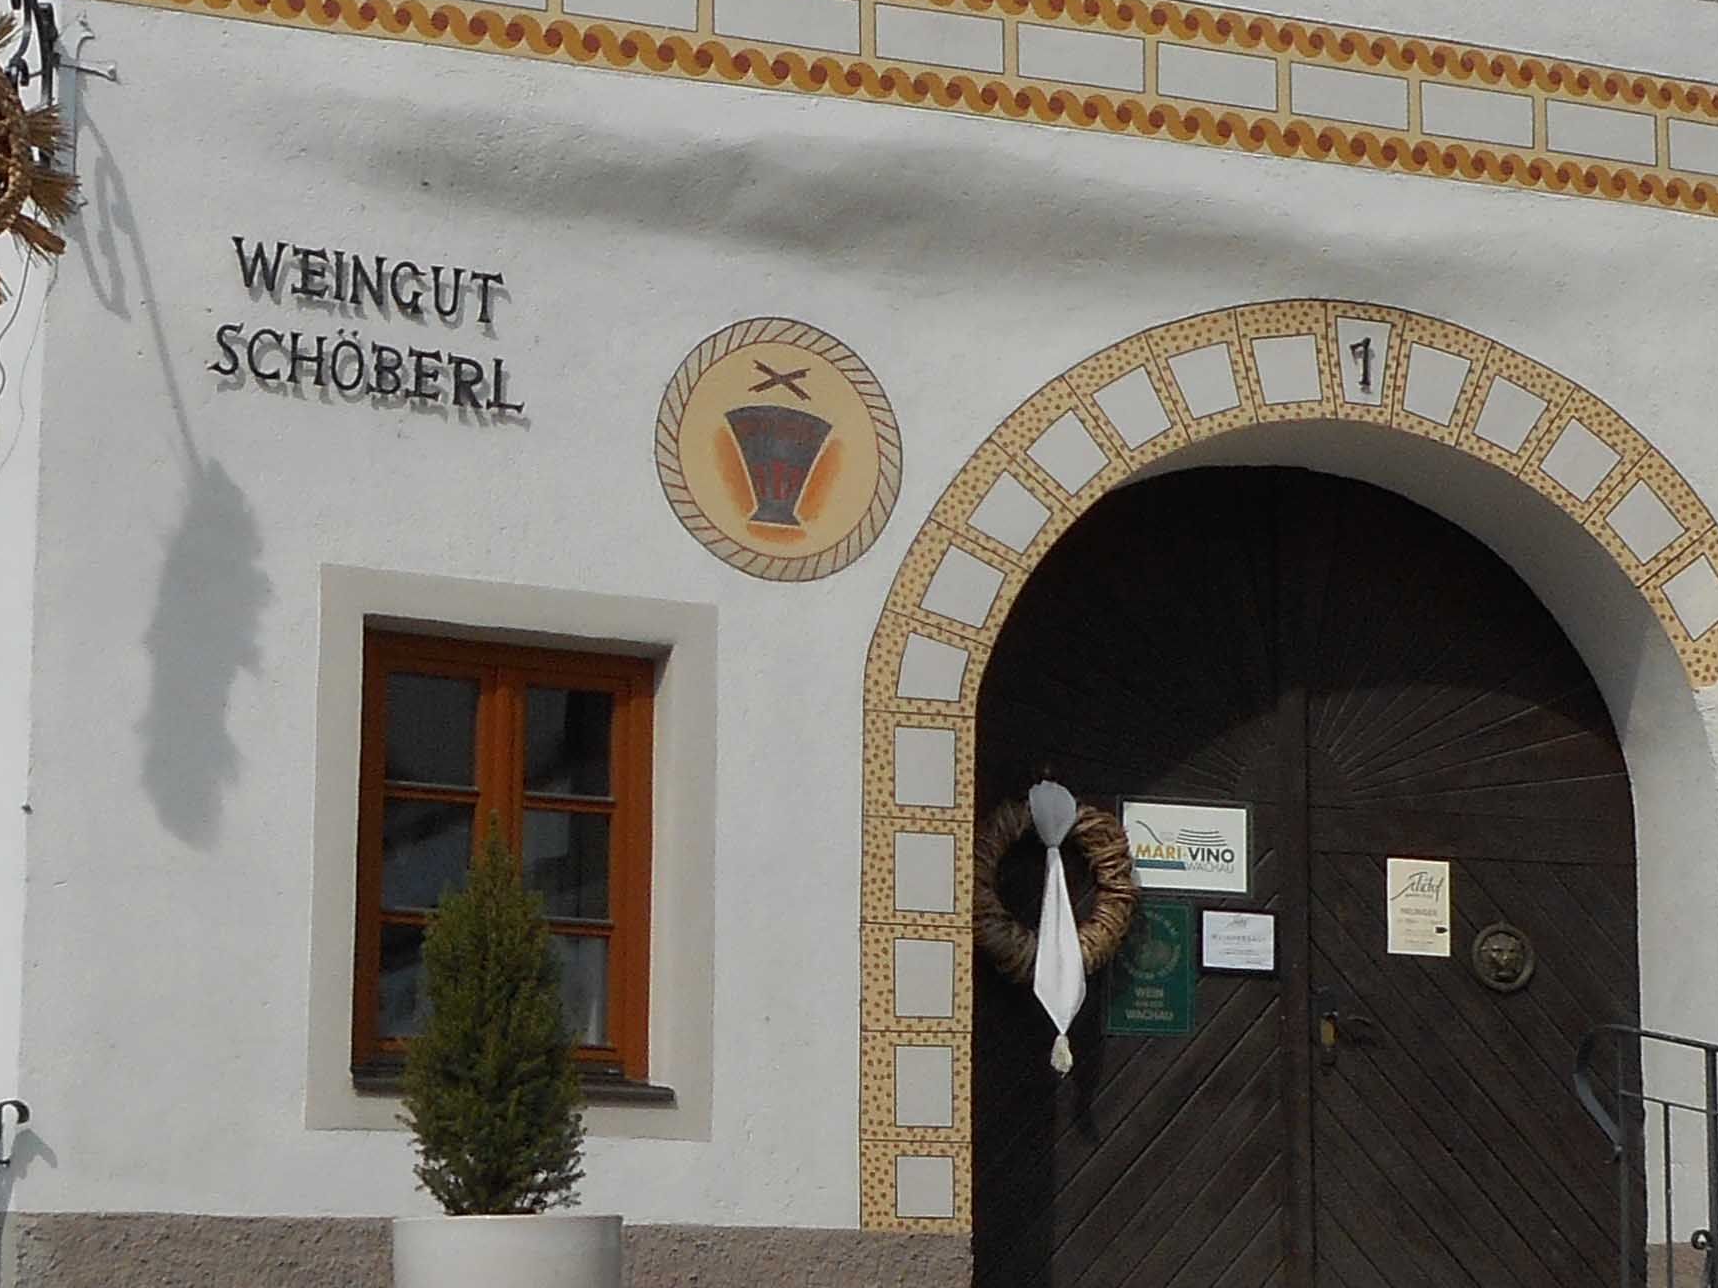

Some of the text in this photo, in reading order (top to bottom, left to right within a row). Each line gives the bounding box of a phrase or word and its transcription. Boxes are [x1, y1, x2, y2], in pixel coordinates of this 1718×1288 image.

[233, 236, 504, 323] WEINGUT
[208, 324, 525, 413] SCHÖBERL
[1349, 337, 1372, 386] 1
